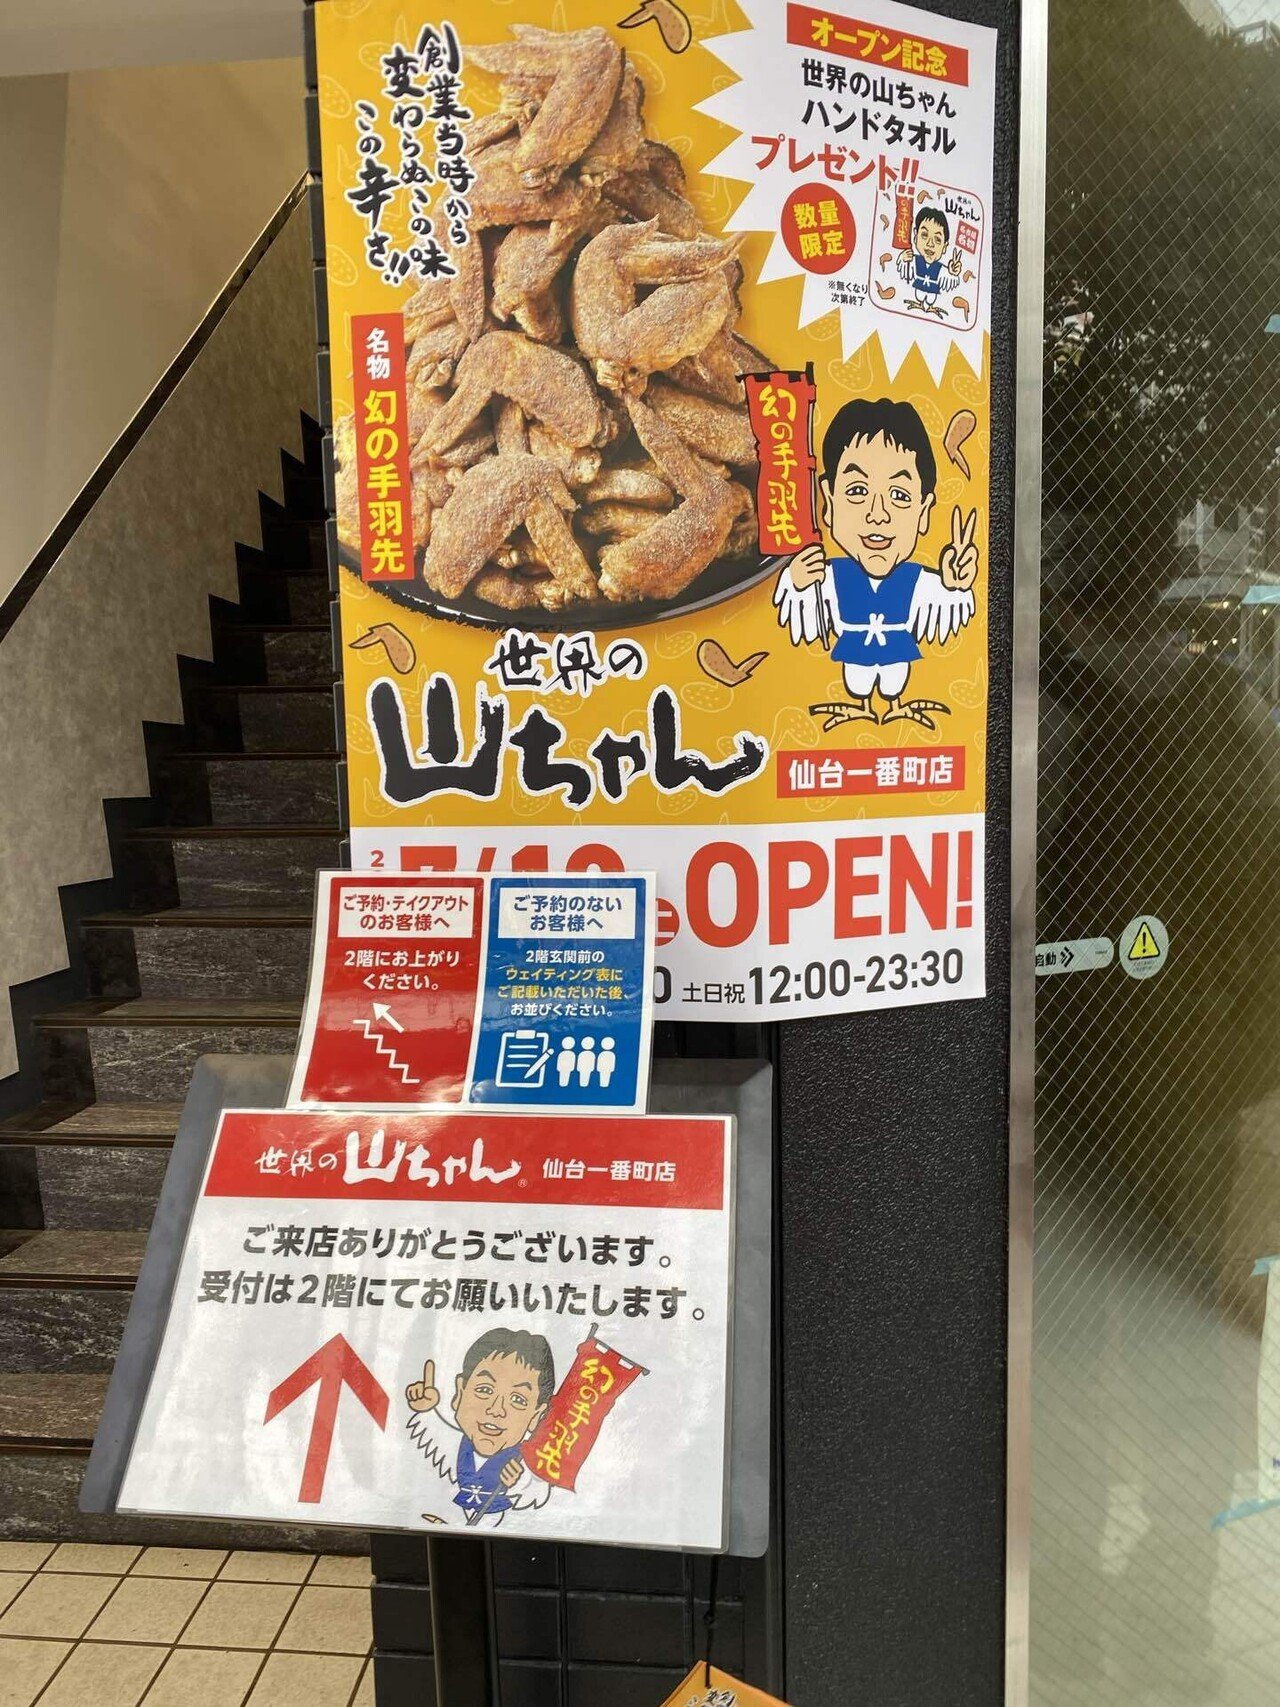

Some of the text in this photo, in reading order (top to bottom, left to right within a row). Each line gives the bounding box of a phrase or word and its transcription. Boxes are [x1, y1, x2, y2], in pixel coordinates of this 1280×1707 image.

[810, 17, 947, 77] オープン記念
[801, 58, 957, 119] 世界の山ちゃん
[417, 23, 475, 244] 創業当時から
[801, 99, 957, 155] ハンドタオル
[380, 45, 457, 279] 変わらぬこの味
[751, 133, 919, 194] プレゼント!!
[793, 200, 841, 229] 数量
[799, 231, 846, 260] 限定
[831, 292, 865, 306] 次第終了
[363, 327, 406, 574] 名物 幻の手羽先
[759, 384, 802, 547] 幻の手羽先
[489, 633, 643, 692] 世界の
[371, 677, 766, 806] 山ちゃん
[788, 754, 955, 791] 仙台一番町店
[343, 894, 469, 912] ご予約・テイクアウト
[513, 894, 622, 912] ご予約のない
[686, 830, 973, 948] OPEN!
[359, 912, 451, 932] のお客様へ
[529, 913, 604, 932] お客様へ
[344, 949, 460, 968] 2階にお上がり
[505, 966, 624, 982] ウェイティング表に
[525, 949, 605, 965] 2階玄関前の
[682, 983, 745, 1005] 土日祝
[748, 948, 963, 1006] 12:00-23:30
[362, 972, 440, 991] ください。
[509, 1002, 613, 1017] お並びください。
[542, 1157, 677, 1183] 仙台一番町店
[243, 1223, 671, 1268] ご来店ありがとうございます。
[197, 1270, 705, 1321] 受付は2階にてお願いいたします。
[535, 1358, 615, 1480] 幻の手羽先
